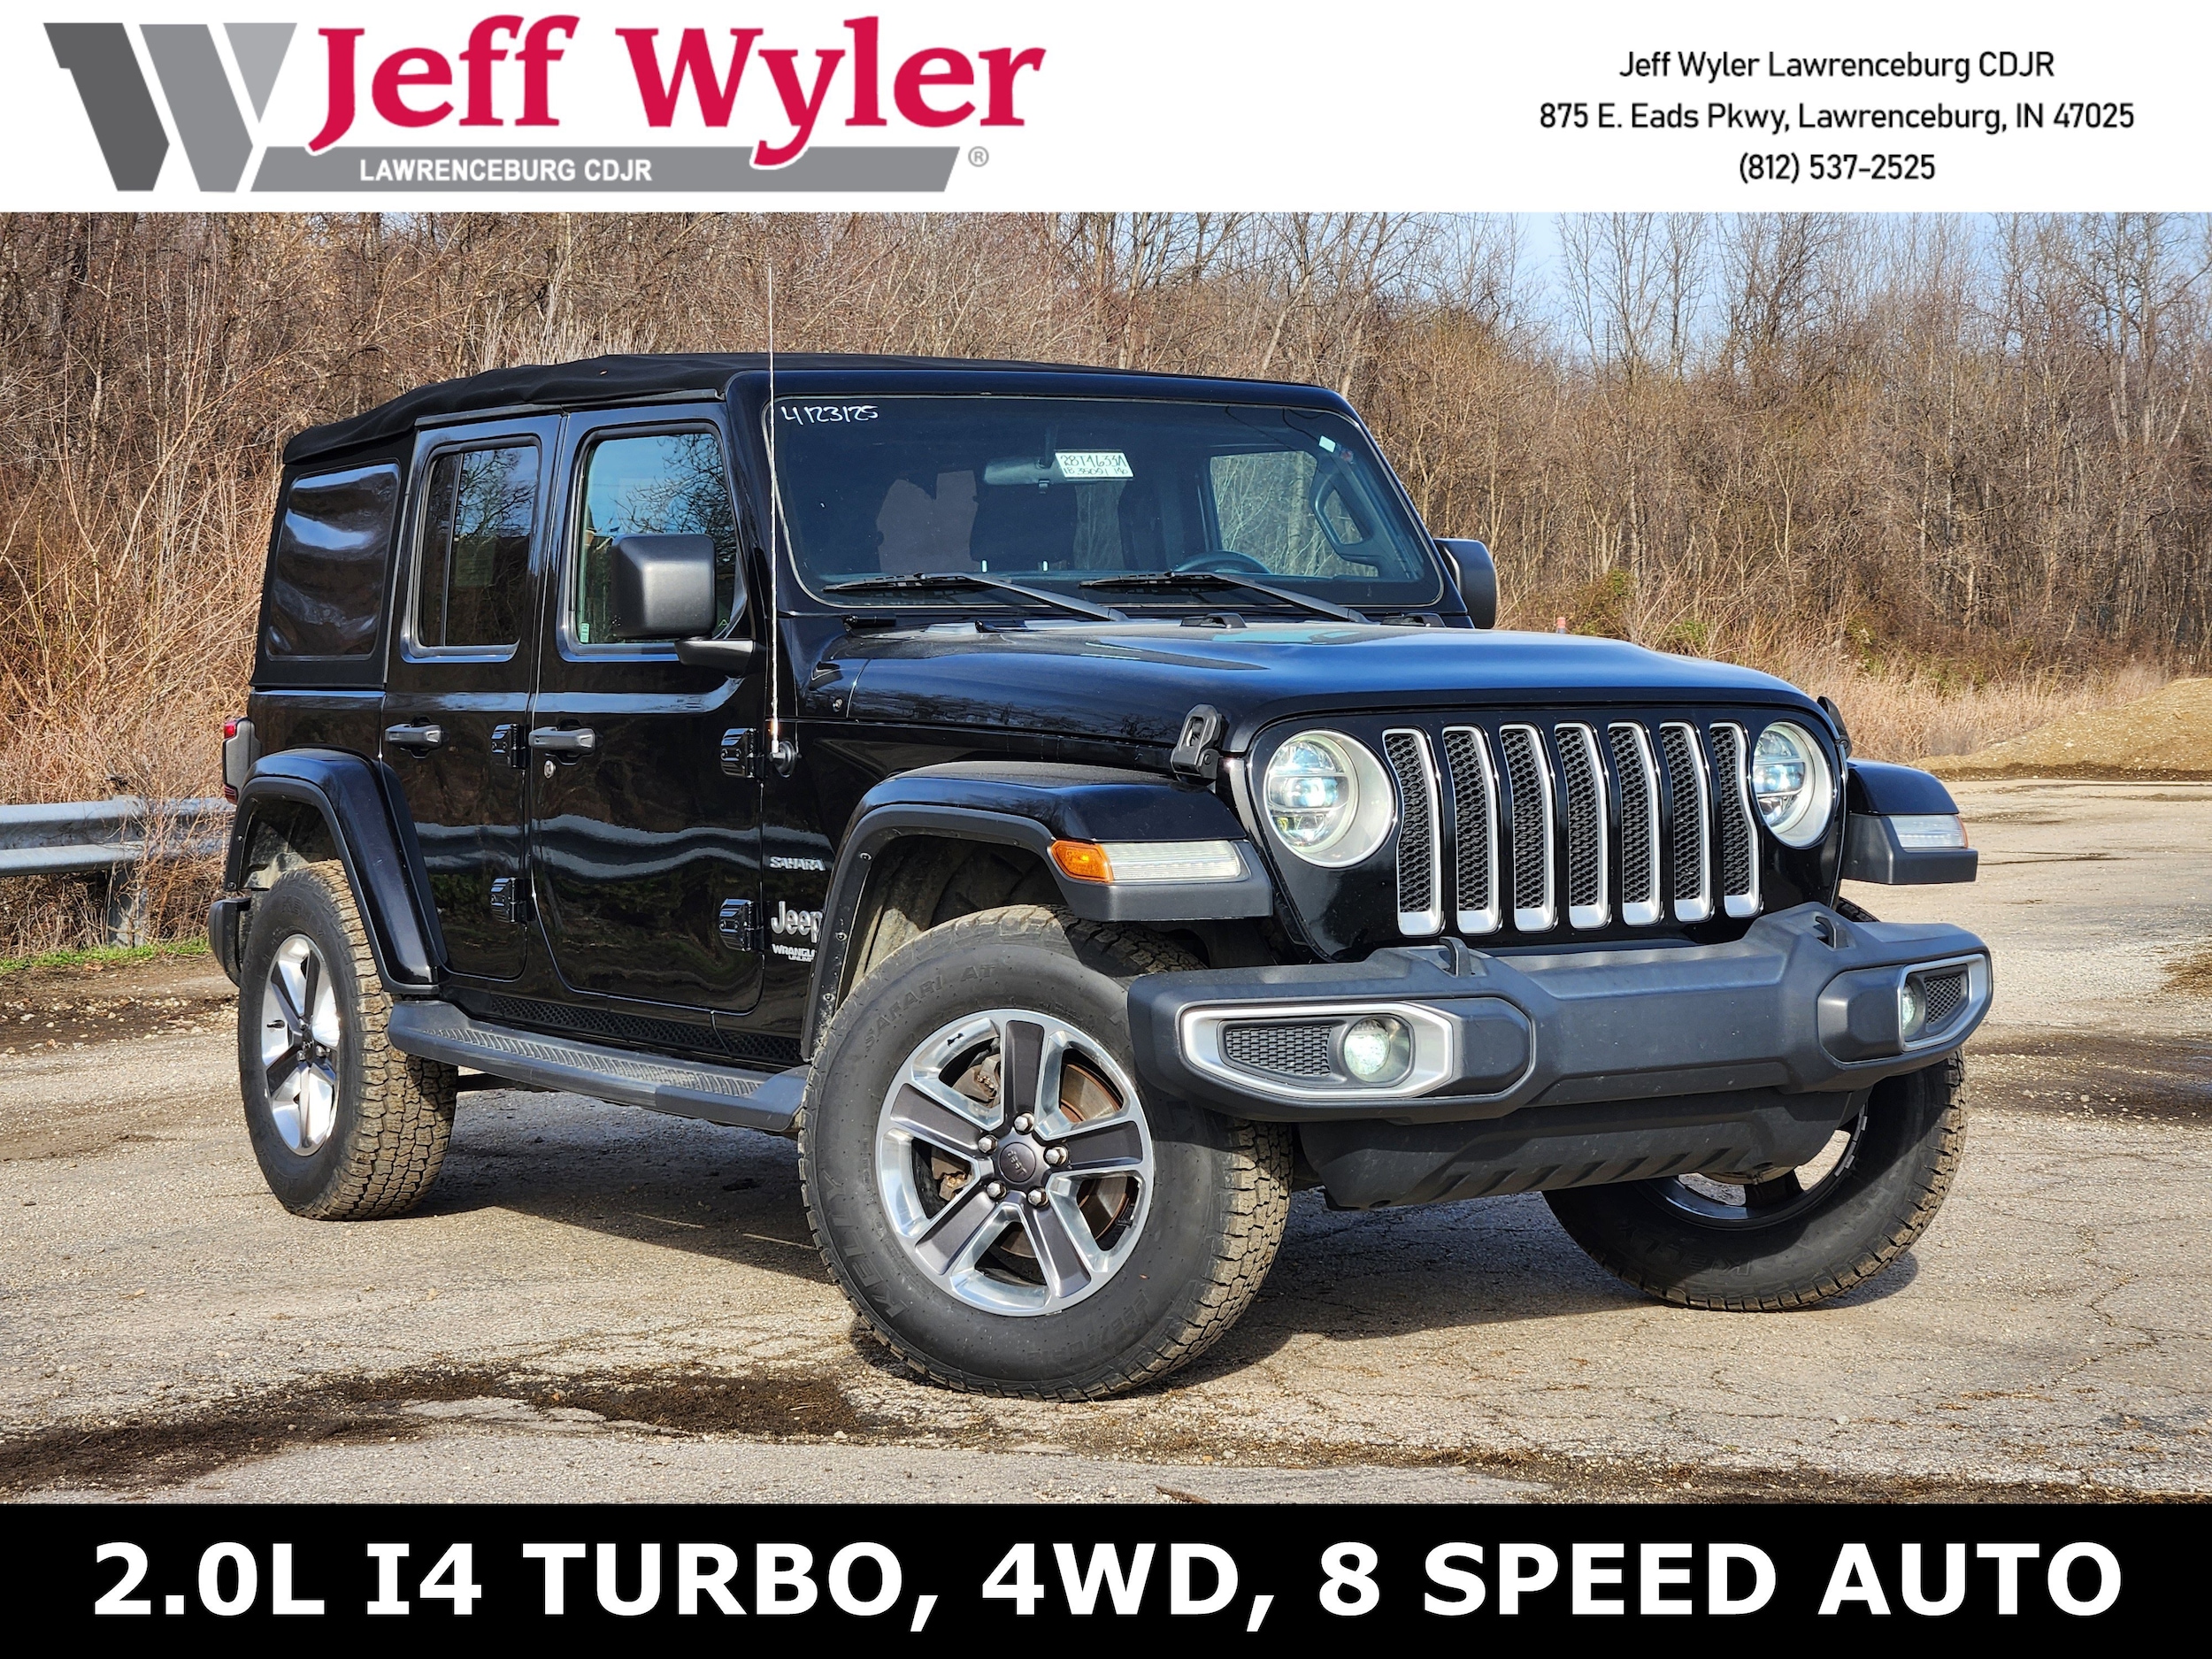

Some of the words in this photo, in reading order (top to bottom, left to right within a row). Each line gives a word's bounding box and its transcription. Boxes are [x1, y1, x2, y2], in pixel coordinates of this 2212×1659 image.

[770, 856, 826, 872] SAHARA
[771, 901, 824, 944] Jeep
[772, 943, 817, 958] WRANGL
[960, 963, 997, 984] AT
